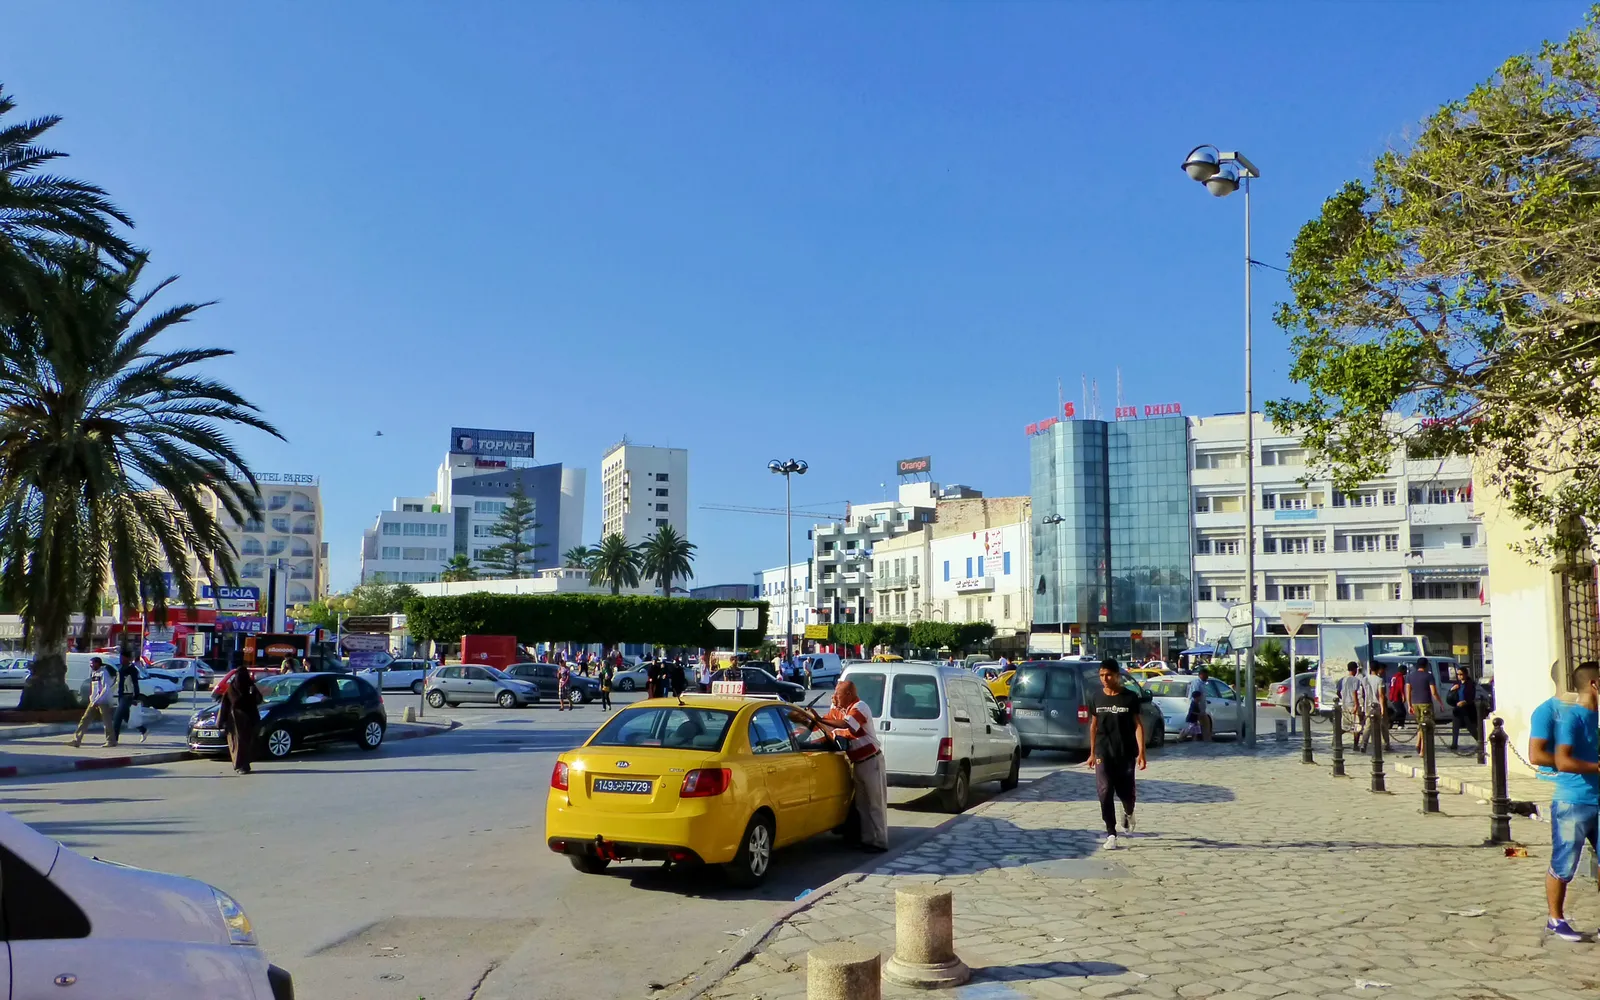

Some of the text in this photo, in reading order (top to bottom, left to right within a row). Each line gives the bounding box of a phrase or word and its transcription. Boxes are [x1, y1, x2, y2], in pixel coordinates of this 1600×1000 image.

[1064, 402, 1075, 417] S
[1115, 403, 1181, 418] BEN DHIAB
[478, 440, 532, 451] TOPNET
[900, 461, 927, 470] Orange
[283, 473, 314, 483] FARES
[599, 780, 613, 790] 149
[626, 781, 648, 792] 5729
